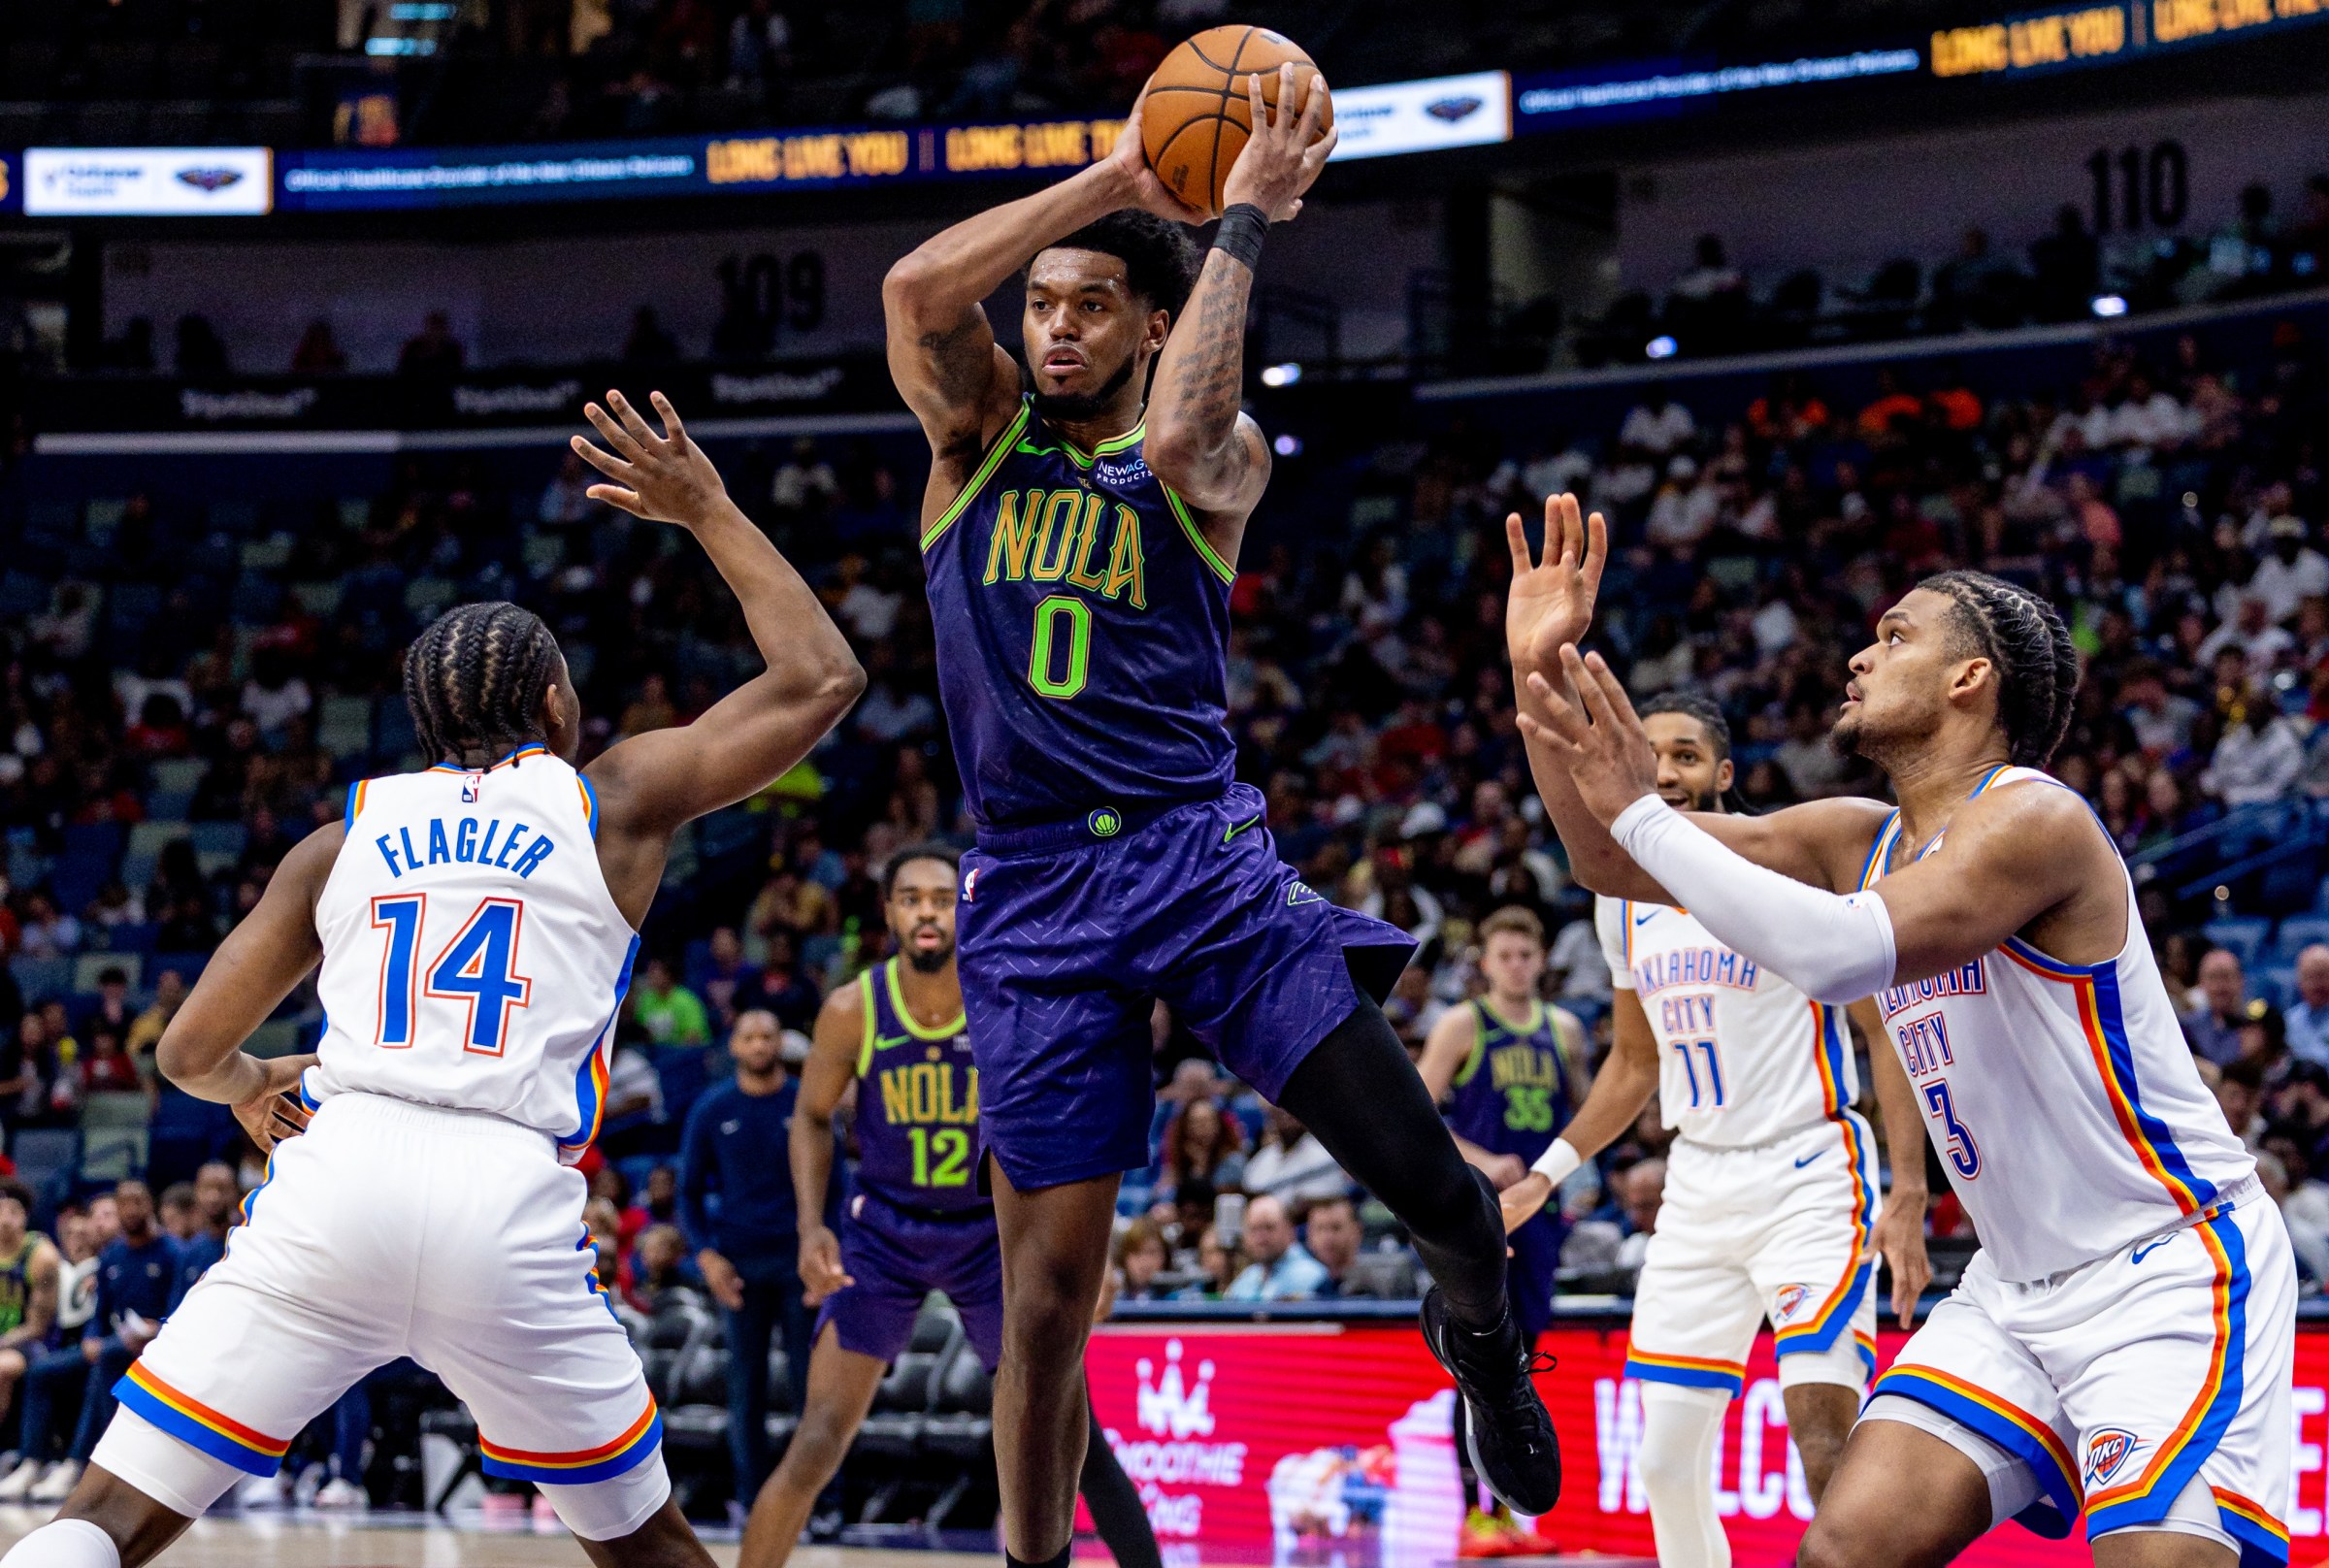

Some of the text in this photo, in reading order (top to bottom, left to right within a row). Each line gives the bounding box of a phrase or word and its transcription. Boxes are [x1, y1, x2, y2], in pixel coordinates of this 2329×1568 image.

[2085, 141, 2188, 229] 110
[1097, 470, 1153, 485] PRODUCTS
[1099, 458, 1148, 476] NEWAG
[982, 488, 1147, 610] NOLA
[1028, 595, 1092, 699] 0
[376, 817, 555, 879] FLAGLER
[371, 893, 532, 1058] 14
[1661, 994, 1716, 1034] CITY
[1897, 1011, 1954, 1077] CITY
[1669, 1037, 1727, 1113] 11
[908, 1127, 968, 1186] 12
[1920, 1078, 1982, 1181] 3
[1102, 1428, 1248, 1486] MOOTHIE
[1139, 1483, 1203, 1537] ING
